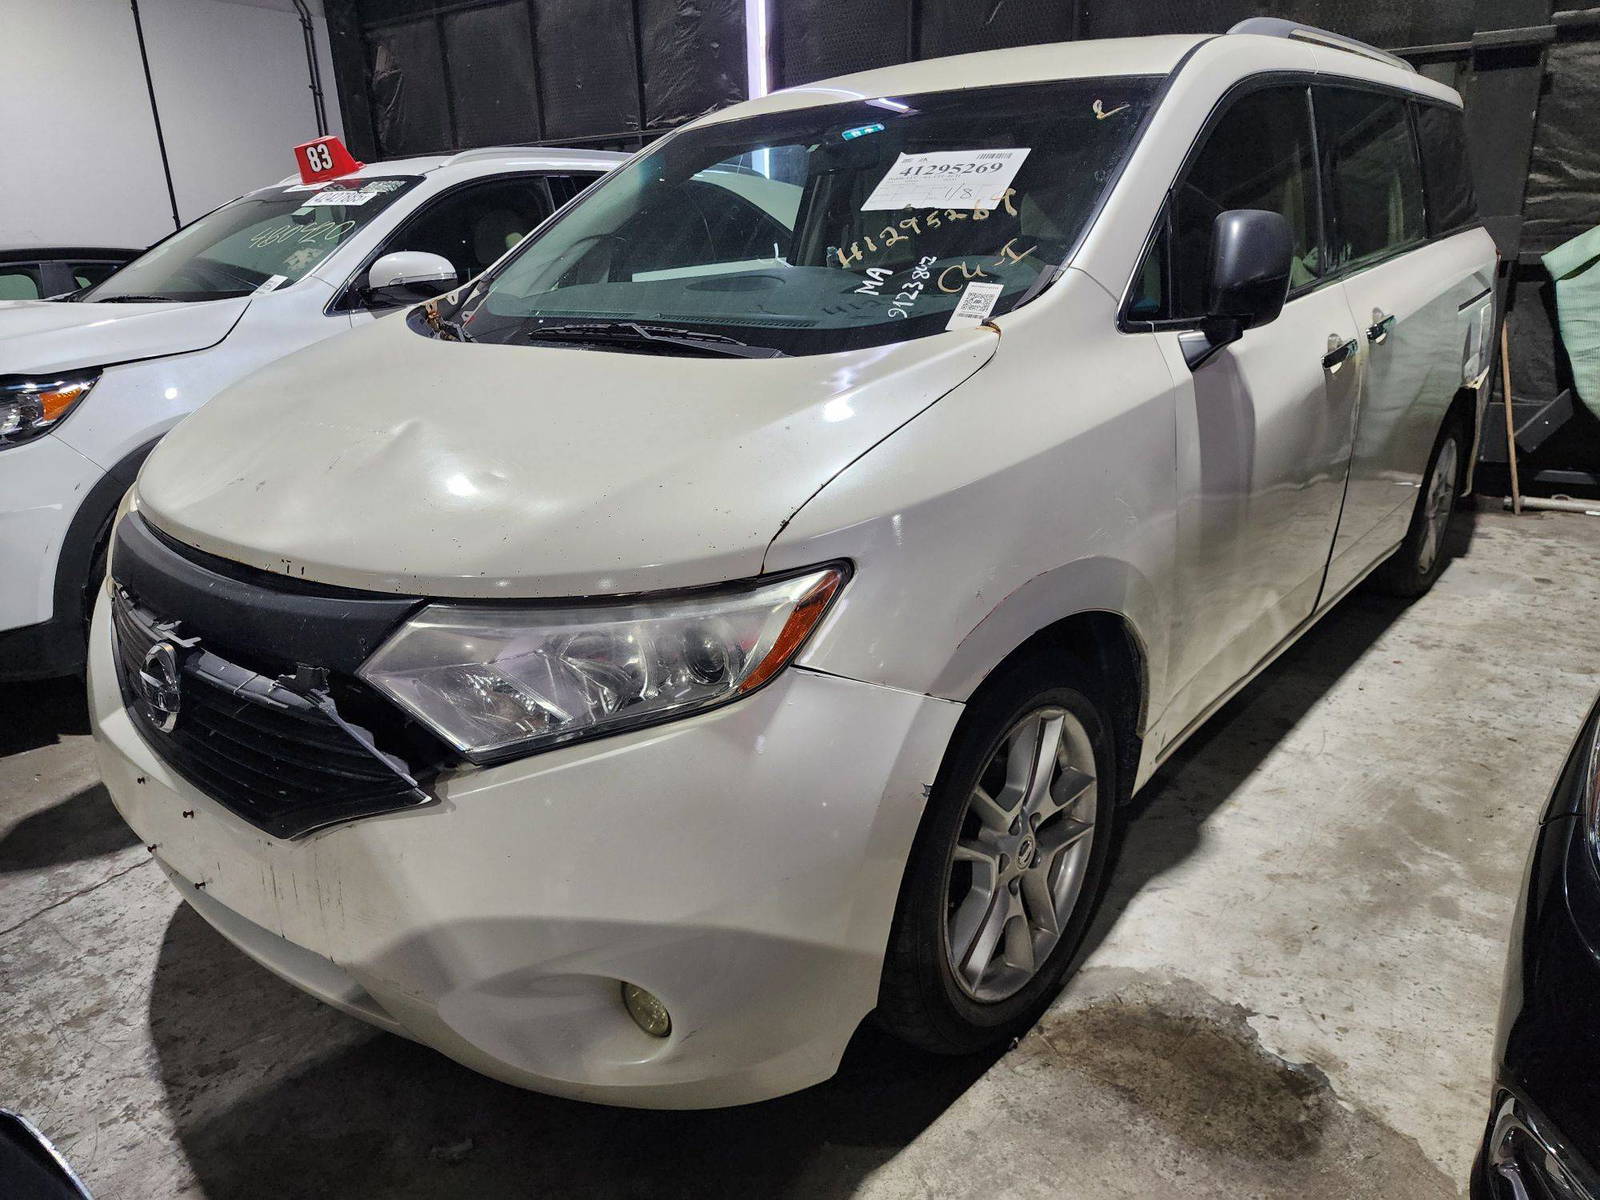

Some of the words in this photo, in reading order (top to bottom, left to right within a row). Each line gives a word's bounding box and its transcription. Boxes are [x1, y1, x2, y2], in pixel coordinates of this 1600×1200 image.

[307, 143, 333, 173] 83
[900, 162, 1004, 177] 41295269
[854, 267, 894, 296] MA
